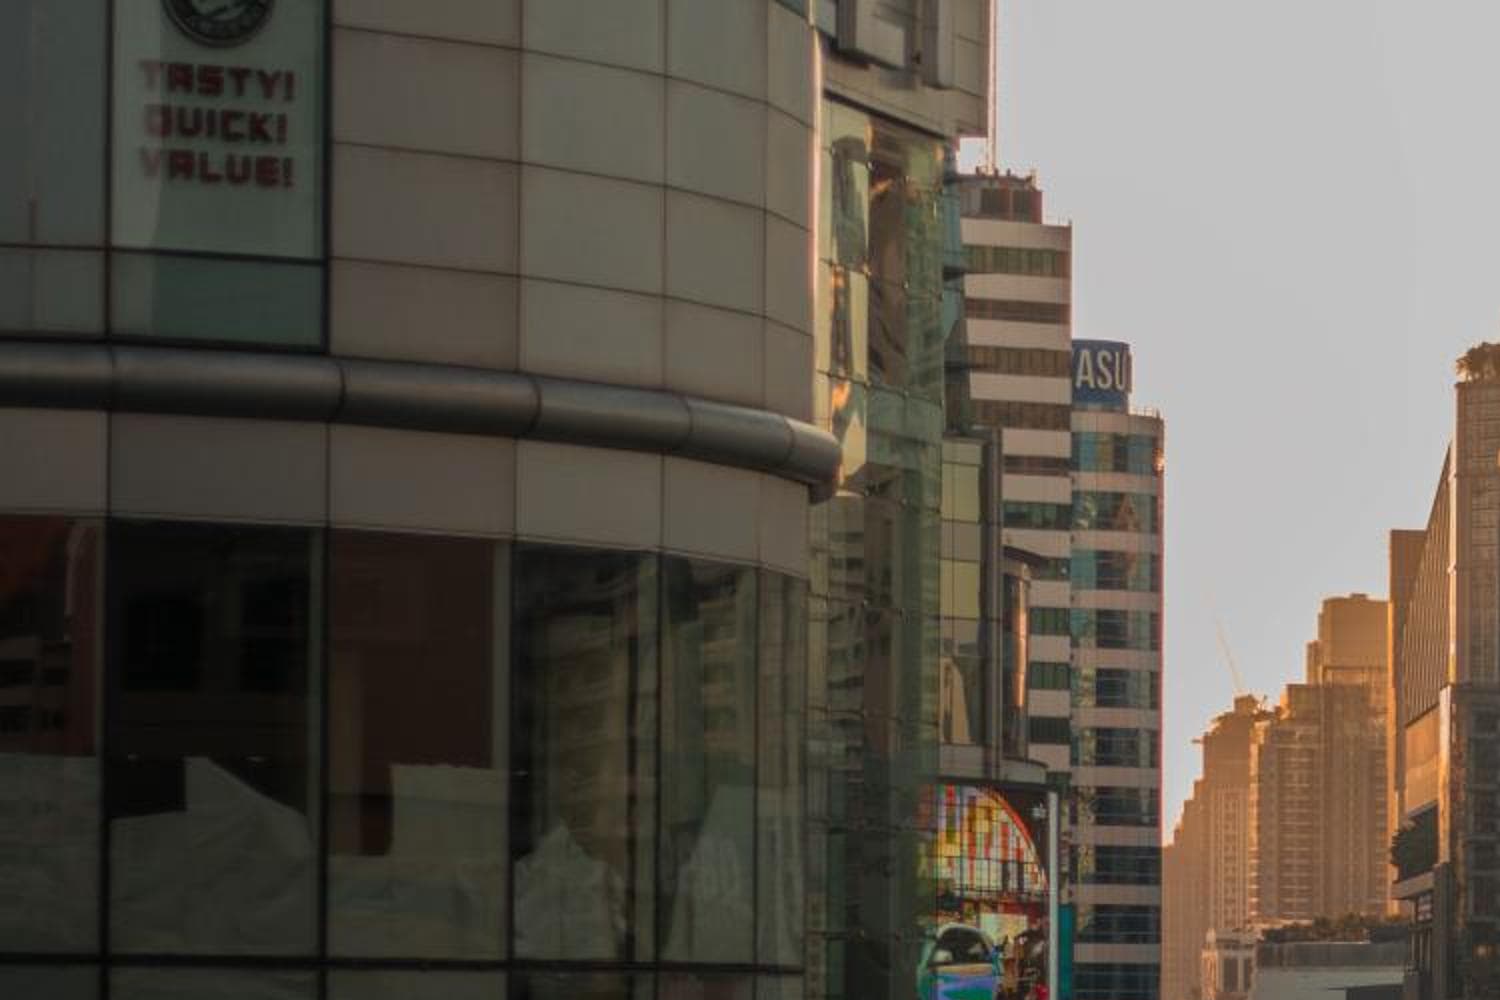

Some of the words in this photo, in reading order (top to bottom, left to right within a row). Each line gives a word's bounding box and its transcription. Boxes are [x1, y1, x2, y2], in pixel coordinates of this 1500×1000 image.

[139, 59, 295, 102] TASTY!
[144, 103, 288, 144] QUICK!
[138, 147, 294, 188] VALUE!
